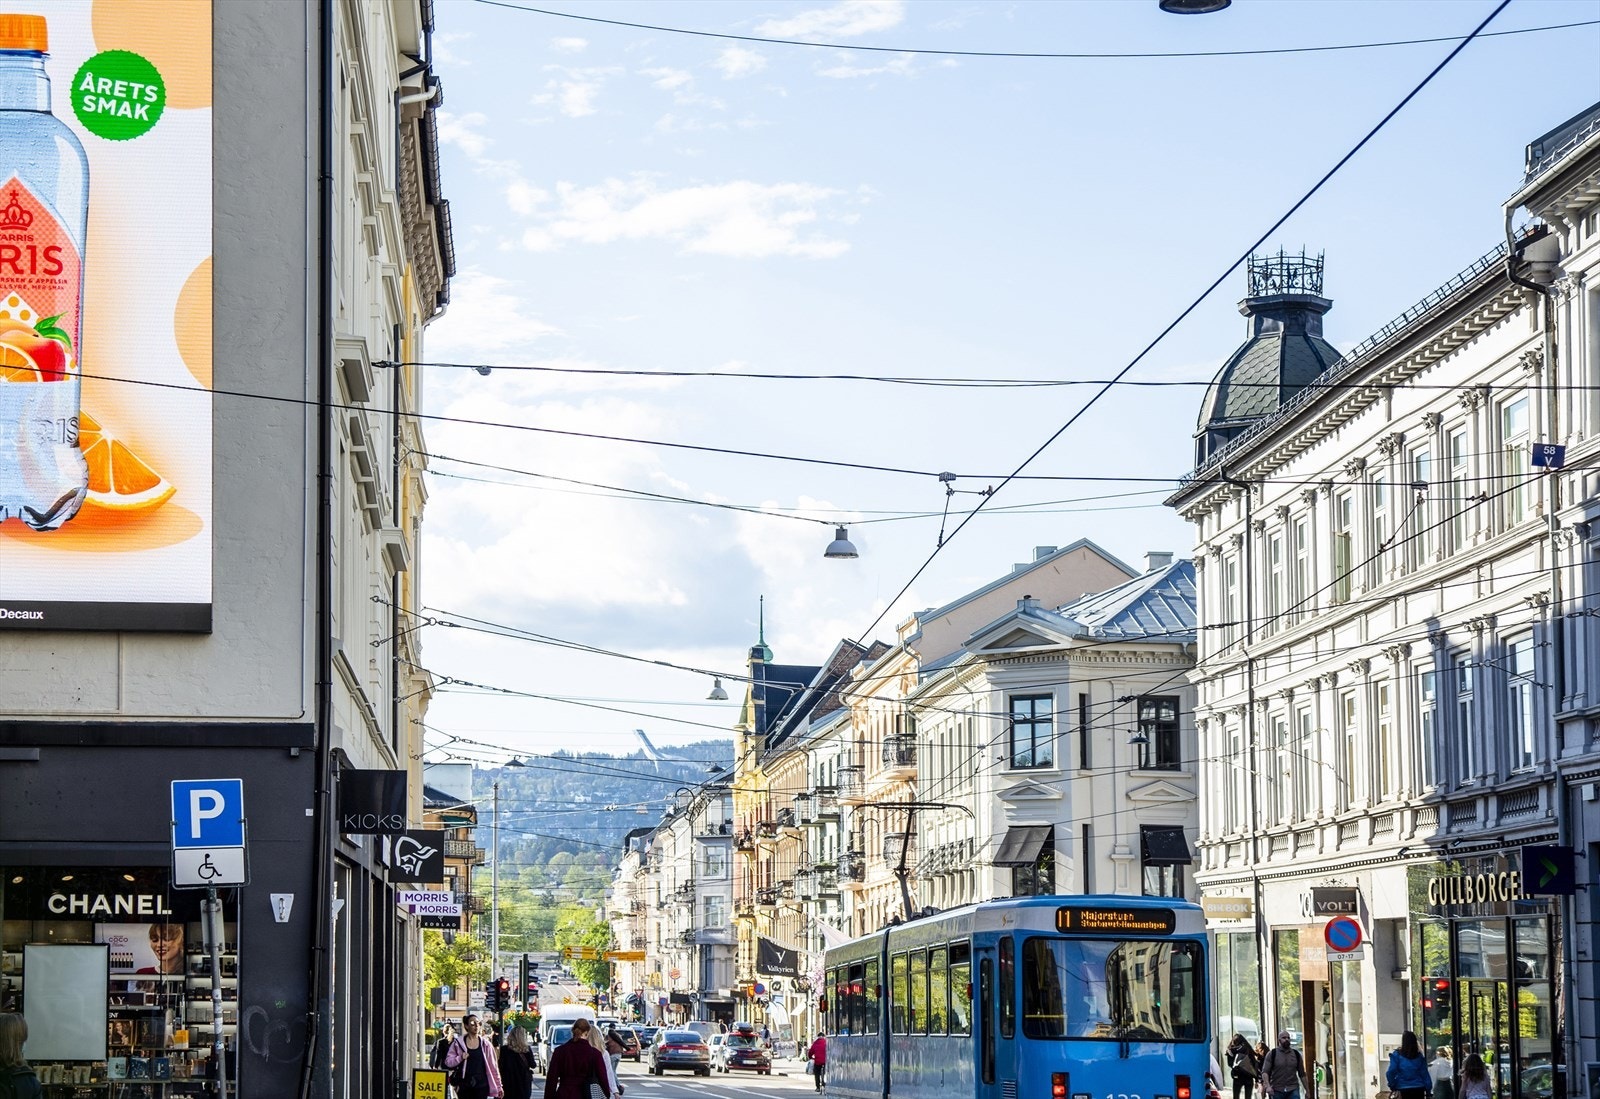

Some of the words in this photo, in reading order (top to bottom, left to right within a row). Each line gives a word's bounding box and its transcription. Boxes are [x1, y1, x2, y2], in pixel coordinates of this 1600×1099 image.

[79, 72, 158, 102] ÅRETS
[82, 95, 150, 121] SMAK
[1543, 446, 1556, 455] 58
[1545, 457, 1553, 466] V
[0, 608, 44, 619] Decaux
[190, 789, 226, 839] P
[344, 813, 403, 830] KICKS
[404, 893, 449, 902] MORRIS
[48, 893, 173, 915] CHANEL
[1226, 904, 1249, 912] BOK
[1317, 901, 1355, 911] VOLT
[420, 905, 458, 914] MORRIS
[1058, 910, 1070, 928] 11
[767, 965, 794, 973] Valkyrien
[418, 1082, 443, 1092] SALE
